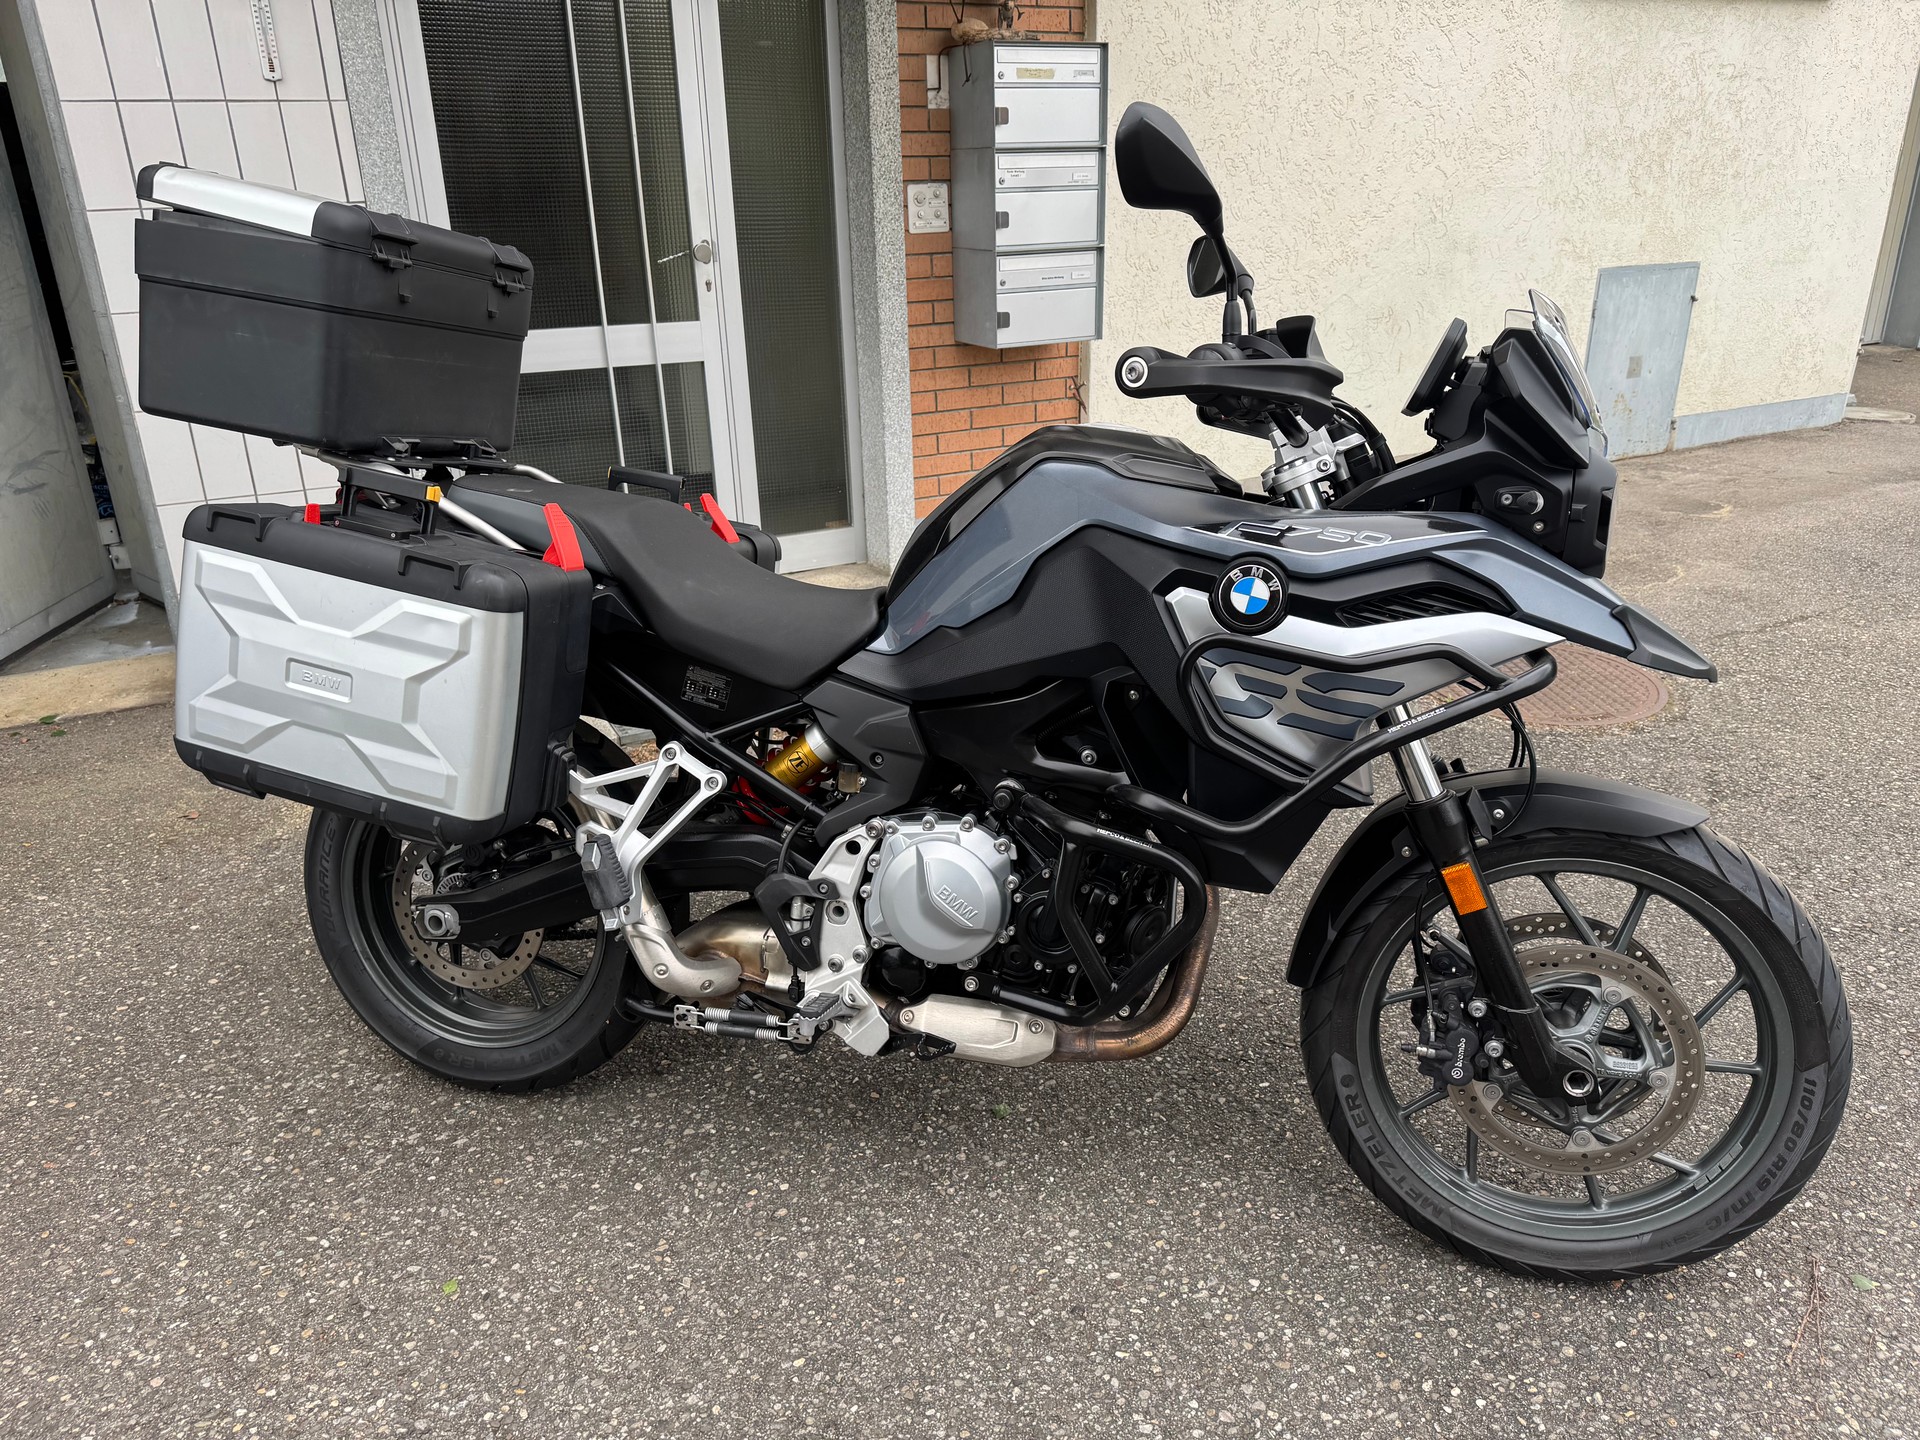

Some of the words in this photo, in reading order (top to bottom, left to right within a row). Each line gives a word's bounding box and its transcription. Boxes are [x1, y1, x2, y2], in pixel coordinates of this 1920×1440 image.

[1230, 566, 1280, 592] BMW
[301, 669, 342, 690] BMW
[789, 751, 809, 773] ZF
[936, 884, 979, 921] BMW
[447, 1043, 561, 1070] METELER
[1454, 1037, 1466, 1067] brembo
[1783, 1076, 1818, 1151] 110/80
[1344, 1092, 1444, 1218] METZELER
[1756, 1152, 1788, 1192] R19
